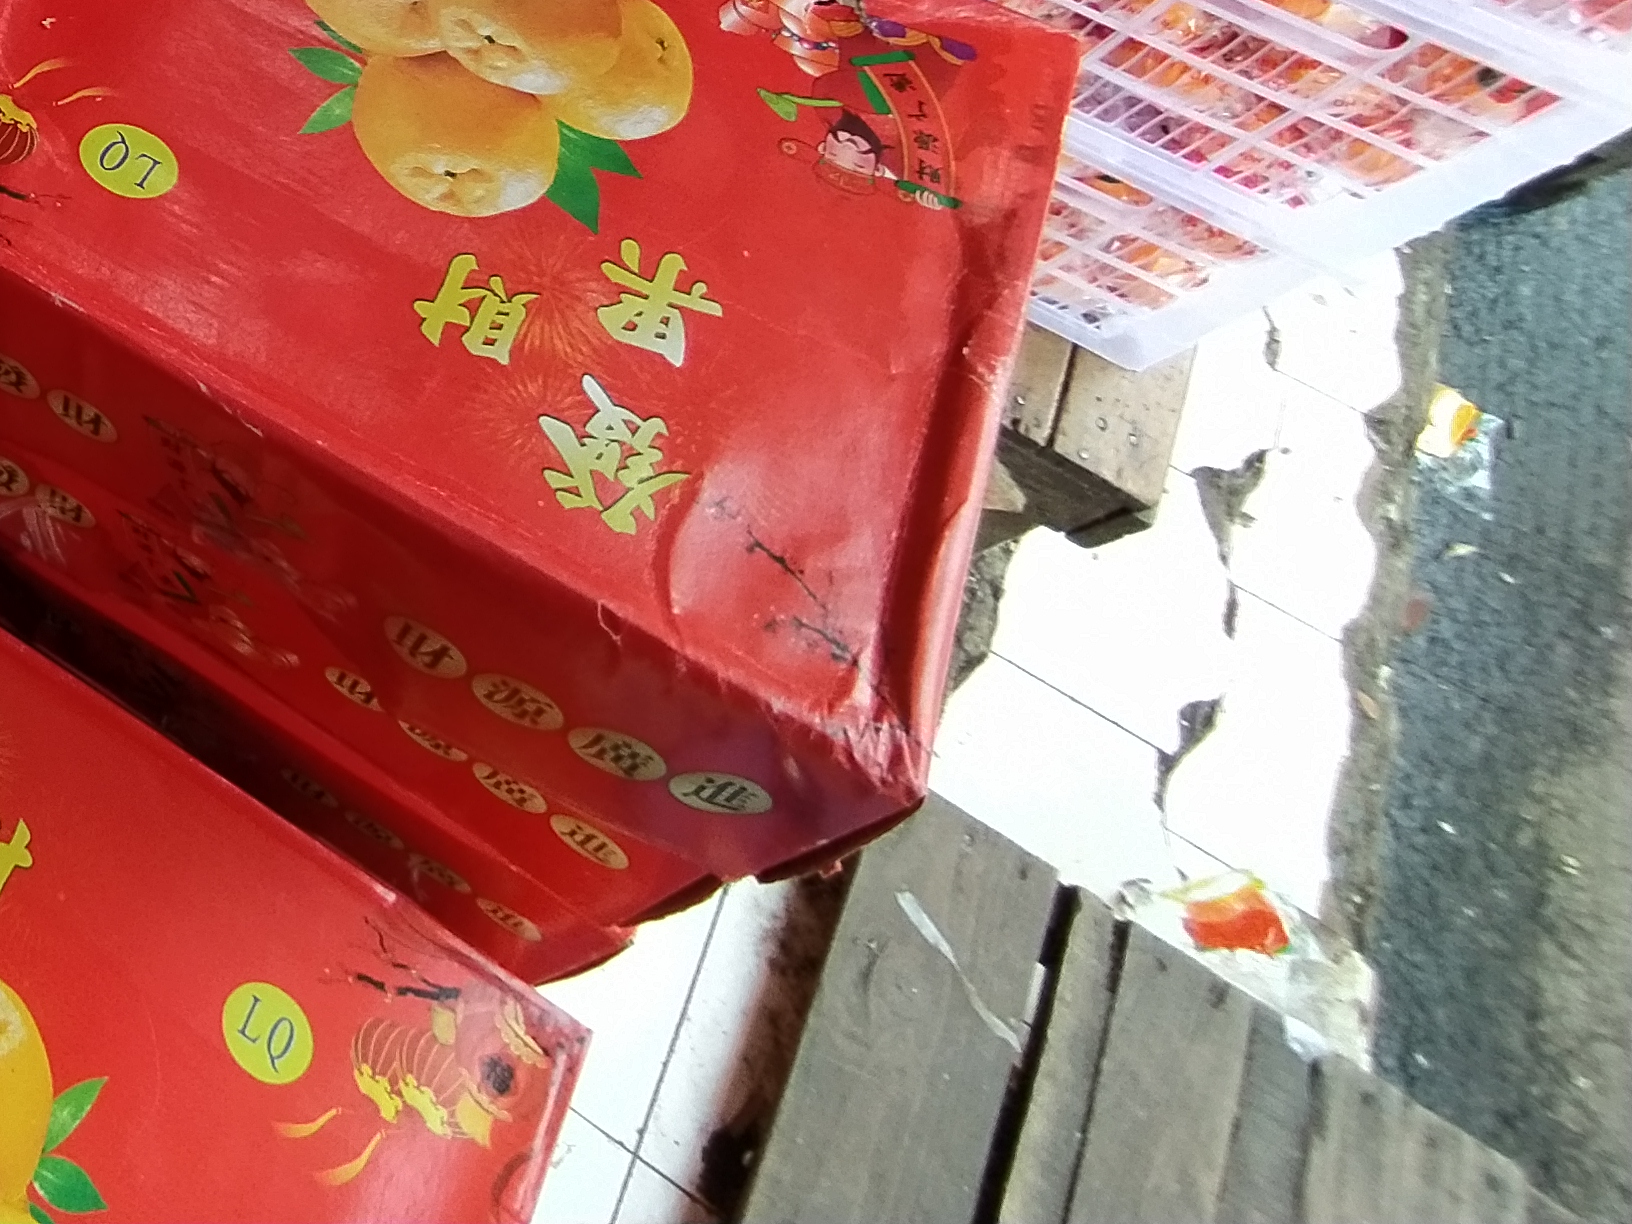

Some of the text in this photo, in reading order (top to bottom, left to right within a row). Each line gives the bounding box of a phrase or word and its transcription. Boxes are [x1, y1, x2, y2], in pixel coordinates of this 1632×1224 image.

[97, 130, 163, 191] LQ
[412, 251, 541, 366] 財
[597, 237, 724, 368] 果
[537, 374, 693, 535] 發
[388, 617, 757, 813] 財源廣進
[236, 993, 297, 1073] LQ
